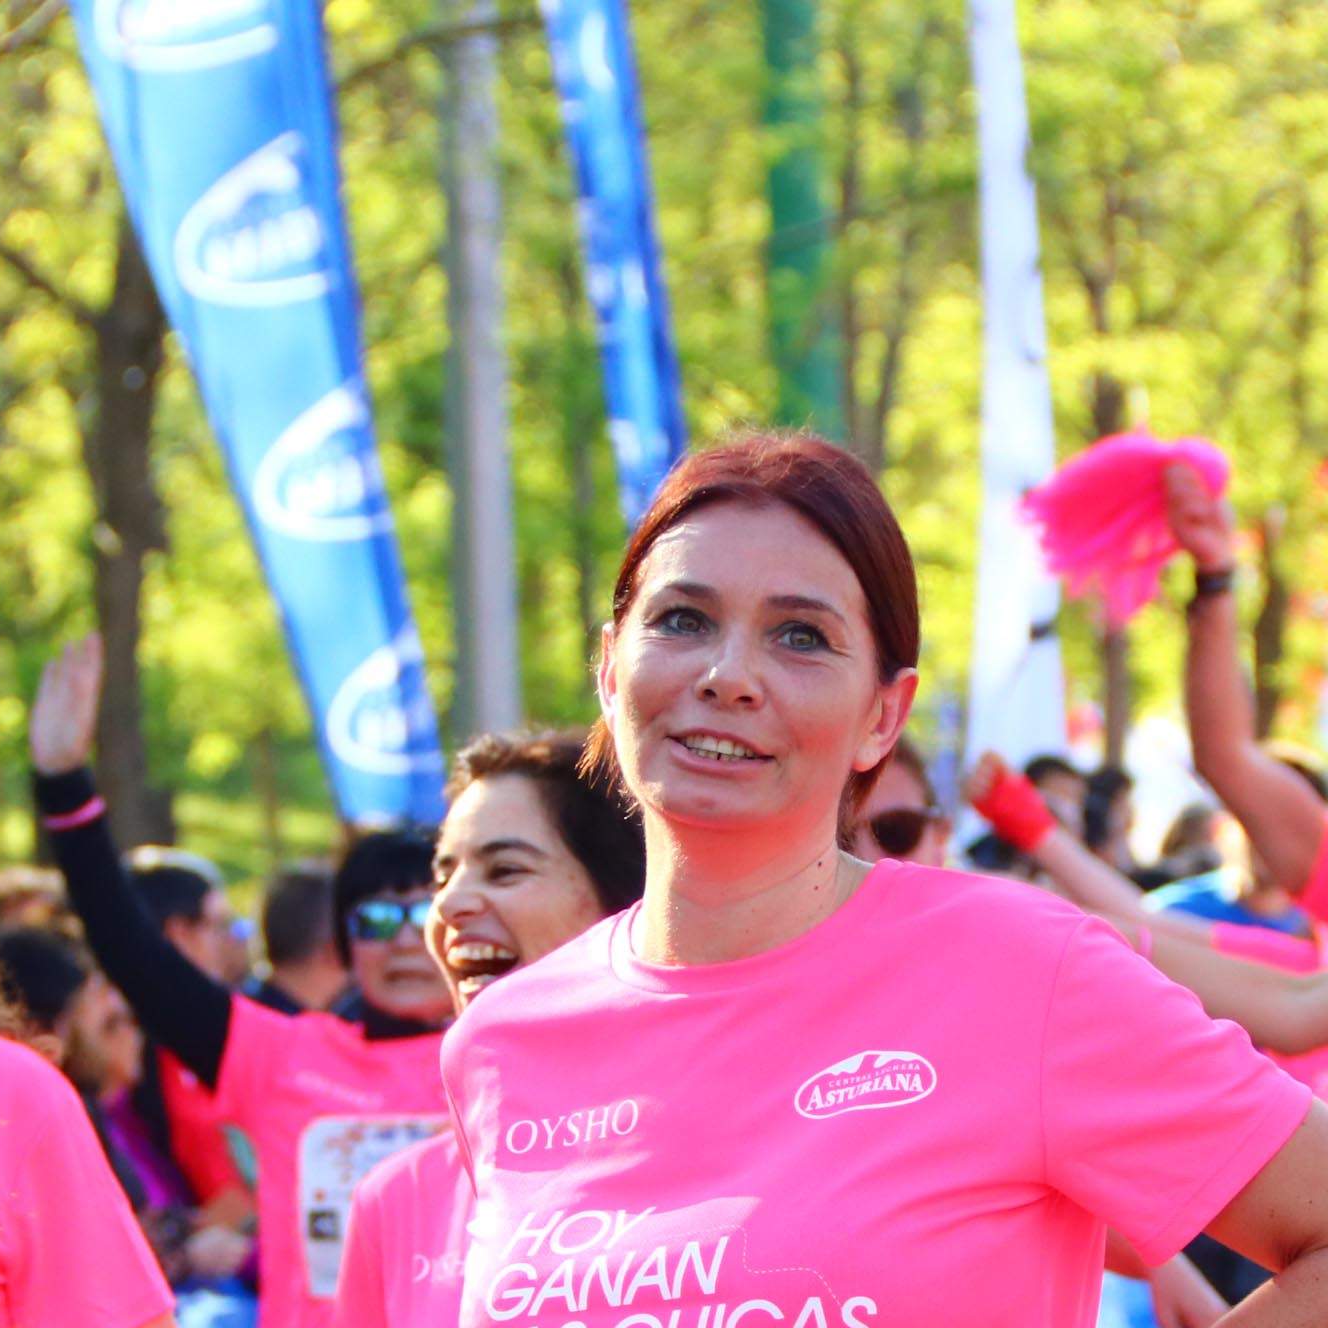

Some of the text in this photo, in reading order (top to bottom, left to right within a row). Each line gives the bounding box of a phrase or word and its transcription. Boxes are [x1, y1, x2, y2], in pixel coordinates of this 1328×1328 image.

[805, 1073, 924, 1112] ASTURIANA
[828, 1074, 872, 1088] CENTRAL
[505, 1098, 640, 1155] OYSHO
[500, 1206, 658, 1259] HOY
[485, 1235, 729, 1321] GANAN
